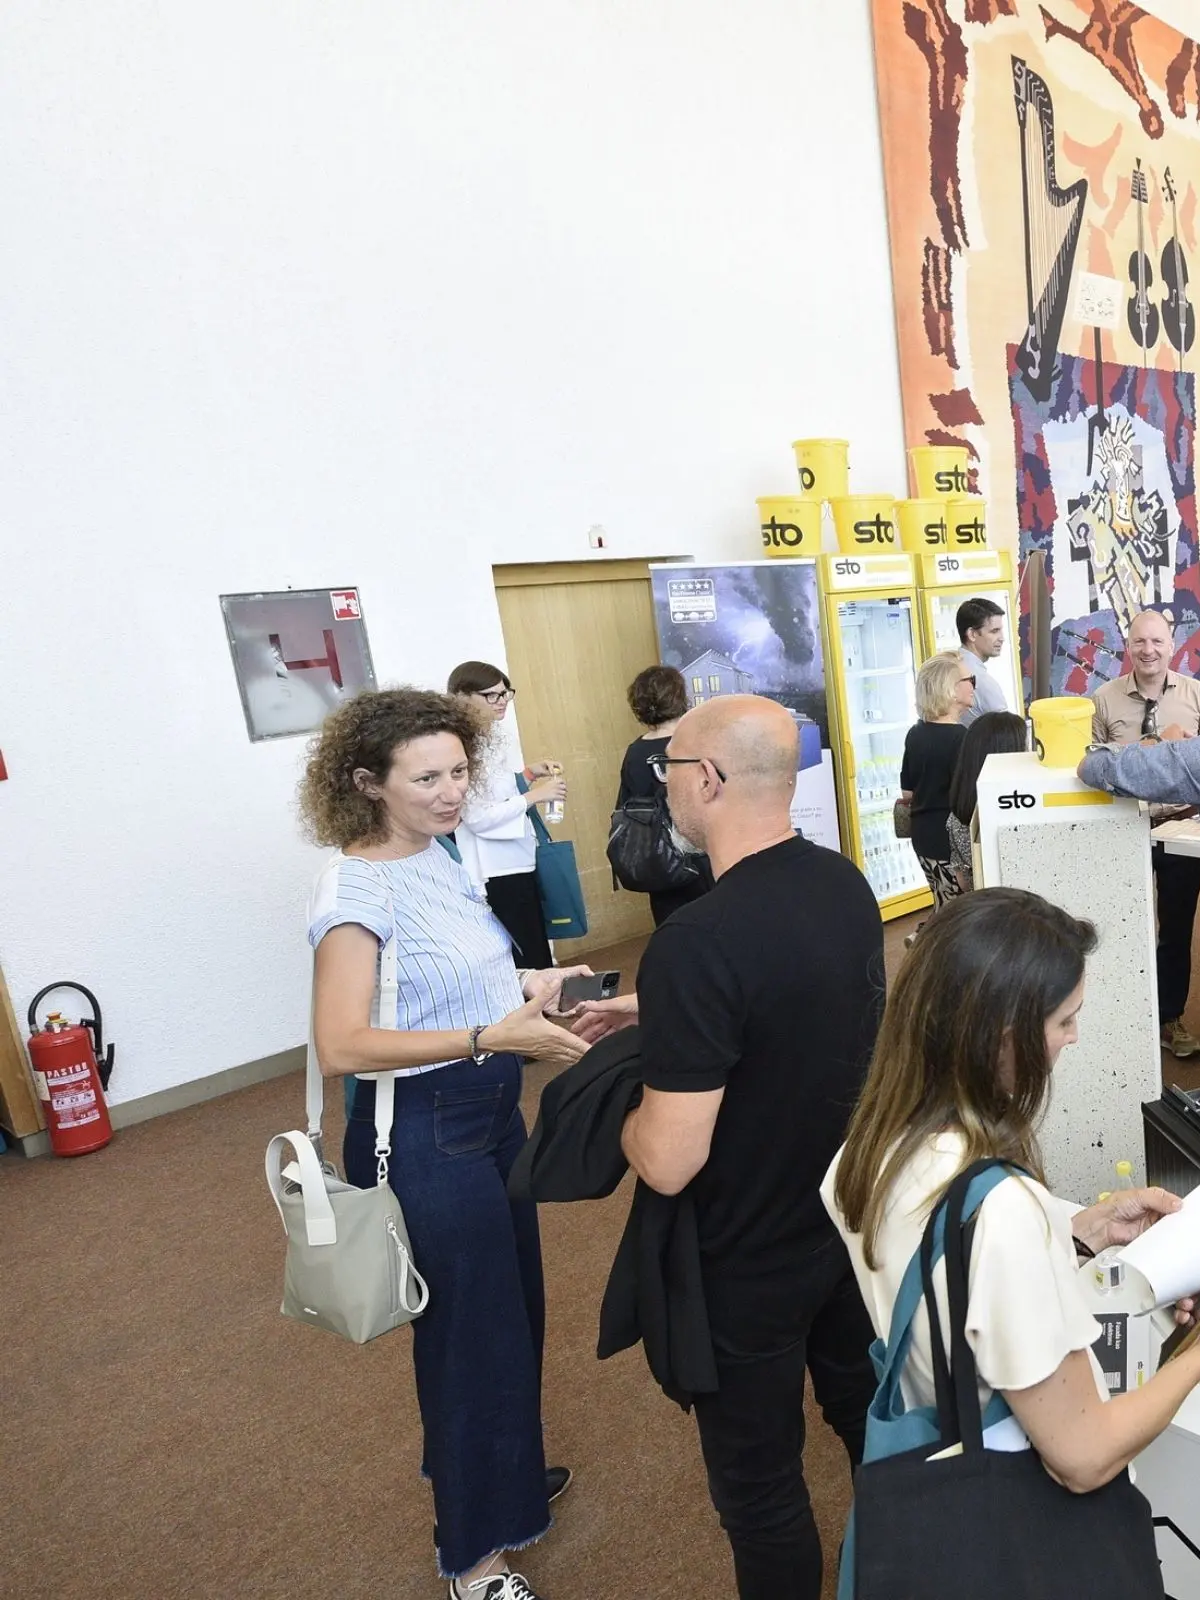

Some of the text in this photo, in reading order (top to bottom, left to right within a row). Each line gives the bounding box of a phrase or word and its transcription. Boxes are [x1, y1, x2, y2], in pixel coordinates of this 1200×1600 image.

[761, 515, 803, 547] sto
[924, 516, 947, 544] st
[835, 559, 861, 575] sto
[938, 556, 959, 571] sto
[998, 789, 1036, 809] sto
